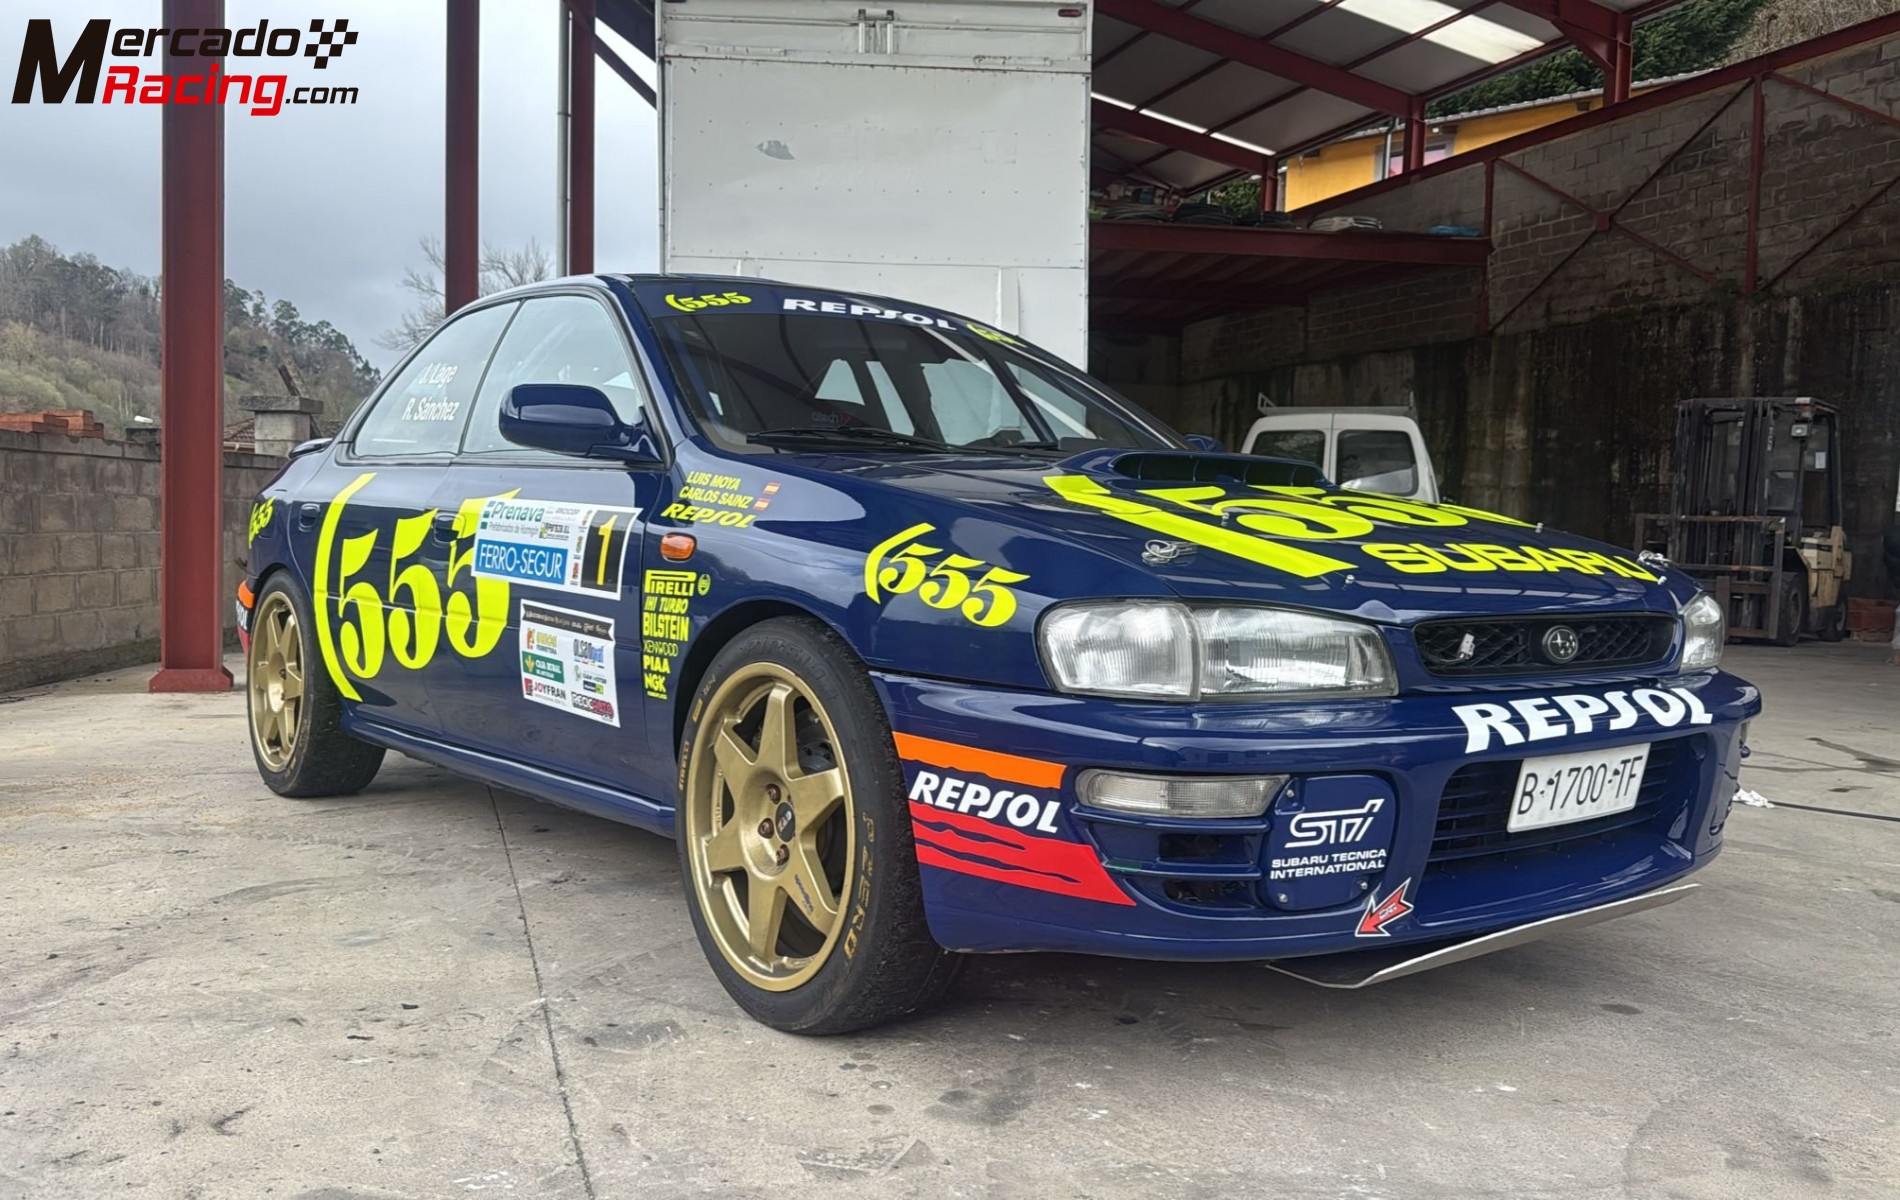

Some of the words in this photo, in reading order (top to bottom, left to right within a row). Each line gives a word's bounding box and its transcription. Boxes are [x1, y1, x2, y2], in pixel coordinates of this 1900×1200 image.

[783, 298, 957, 331] REPSOL
[429, 362, 458, 389] Lage
[413, 396, 460, 421] Sánchez
[687, 471, 712, 486] LUIS
[710, 475, 741, 490] MOYA
[679, 486, 720, 503] CARLOS
[718, 493, 754, 509] SAINZ
[491, 501, 545, 522] Prenava
[661, 503, 757, 528] REPSOL
[479, 544, 563, 579] FERRO-SEGUR
[596, 515, 618, 585] 1
[1361, 543, 1660, 583] SUBARU
[644, 569, 697, 596] PIRELLI
[659, 596, 689, 614] TURBO
[643, 612, 689, 641] BILSTEIN
[643, 640, 678, 656] KENWOOD
[643, 655, 671, 674] PIAA
[534, 682, 567, 700] JOYFRAN
[644, 673, 666, 692] NGK
[1451, 688, 1713, 754] REPSOL
[908, 770, 1060, 836] REPSOL
[1270, 860, 1386, 879] INTERNATIONAL
[1272, 854, 1328, 868] SUBARU
[1331, 848, 1387, 862] TECNICA
